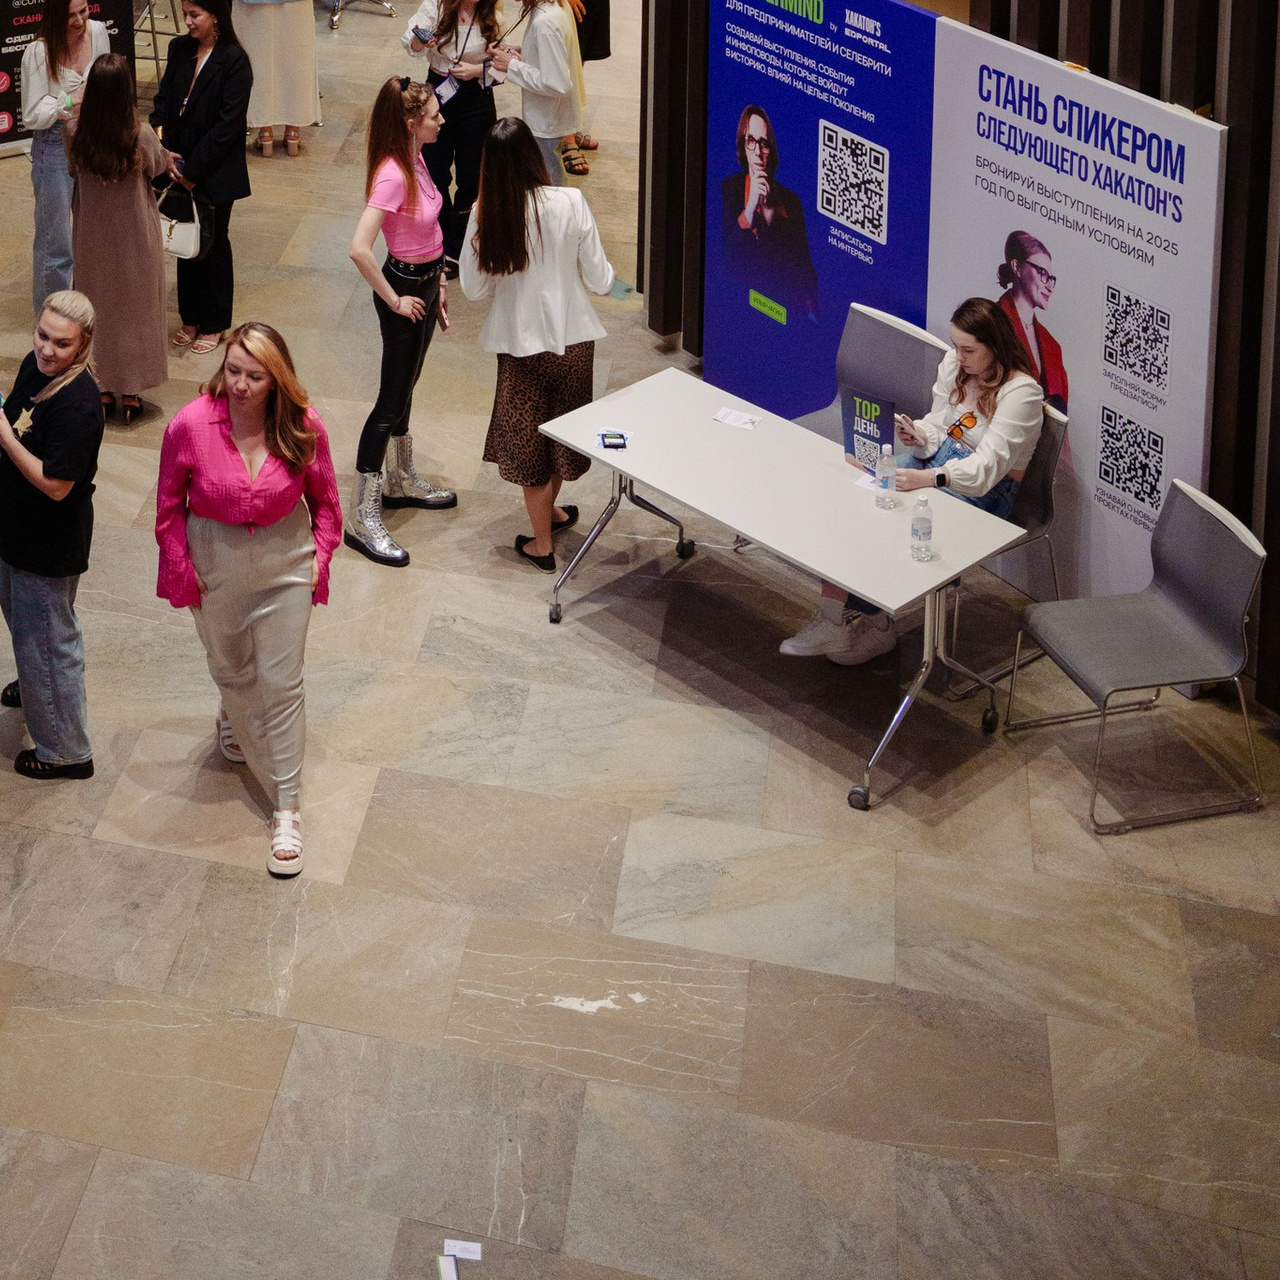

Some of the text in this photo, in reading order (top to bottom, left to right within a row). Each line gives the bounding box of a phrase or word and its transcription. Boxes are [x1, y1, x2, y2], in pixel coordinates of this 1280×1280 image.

[5, 33, 36, 44] СДЕЛ
[744, 3, 831, 52] ПРЕДПРИНИМАТЕЛЕЙ
[832, 44, 839, 54] И
[839, 46, 892, 77] СЕЛЕБРИТИ
[830, 22, 838, 32] by
[844, 28, 892, 54] EDPORTAL
[845, 8, 881, 37] ХАКАТОН'S
[725, 22, 855, 87] СОЗДАВАЙ ВЫСТУПЛЕНИЯ, СОБЫТИЯ
[725, 35, 848, 97] И ИНФОПОВОДЫ, КОТОРЫЕ ВОЙДУТ
[725, 48, 875, 123] В ИСТОРИЮ. ВЛИЯЙ НА ЦЕЛЫЕ ПОКОЛЕНИЯ
[979, 64, 1185, 185] СТАНЬ СПИКЕРОМ
[976, 111, 1183, 223] СЛЕДУЮЩЕГО ХАКАТОН'S
[975, 155, 1179, 256] БРОНИРУЙ ВЫСТУПЛЕНИЯ НА 2025
[975, 175, 1155, 267] ГОД ПО ВЫГОДНЫМ УСЛОВИЯМ
[828, 235, 873, 265] НА ИНТЕРВЬЮ
[830, 226, 872, 254] ЗАПИСАТЬСЯ
[1102, 368, 1167, 406] ЗАПОЛНЯЙ ФОРМУ
[1110, 381, 1158, 411] ПРЕДЗАПИСИ
[854, 416, 881, 439] ДЕНЬ
[1094, 494, 1155, 533] ПРОЕКТАХ ПЕРВЫ
[1095, 485, 1126, 507] УЗНАВАЙ
[1127, 504, 1133, 512] О
